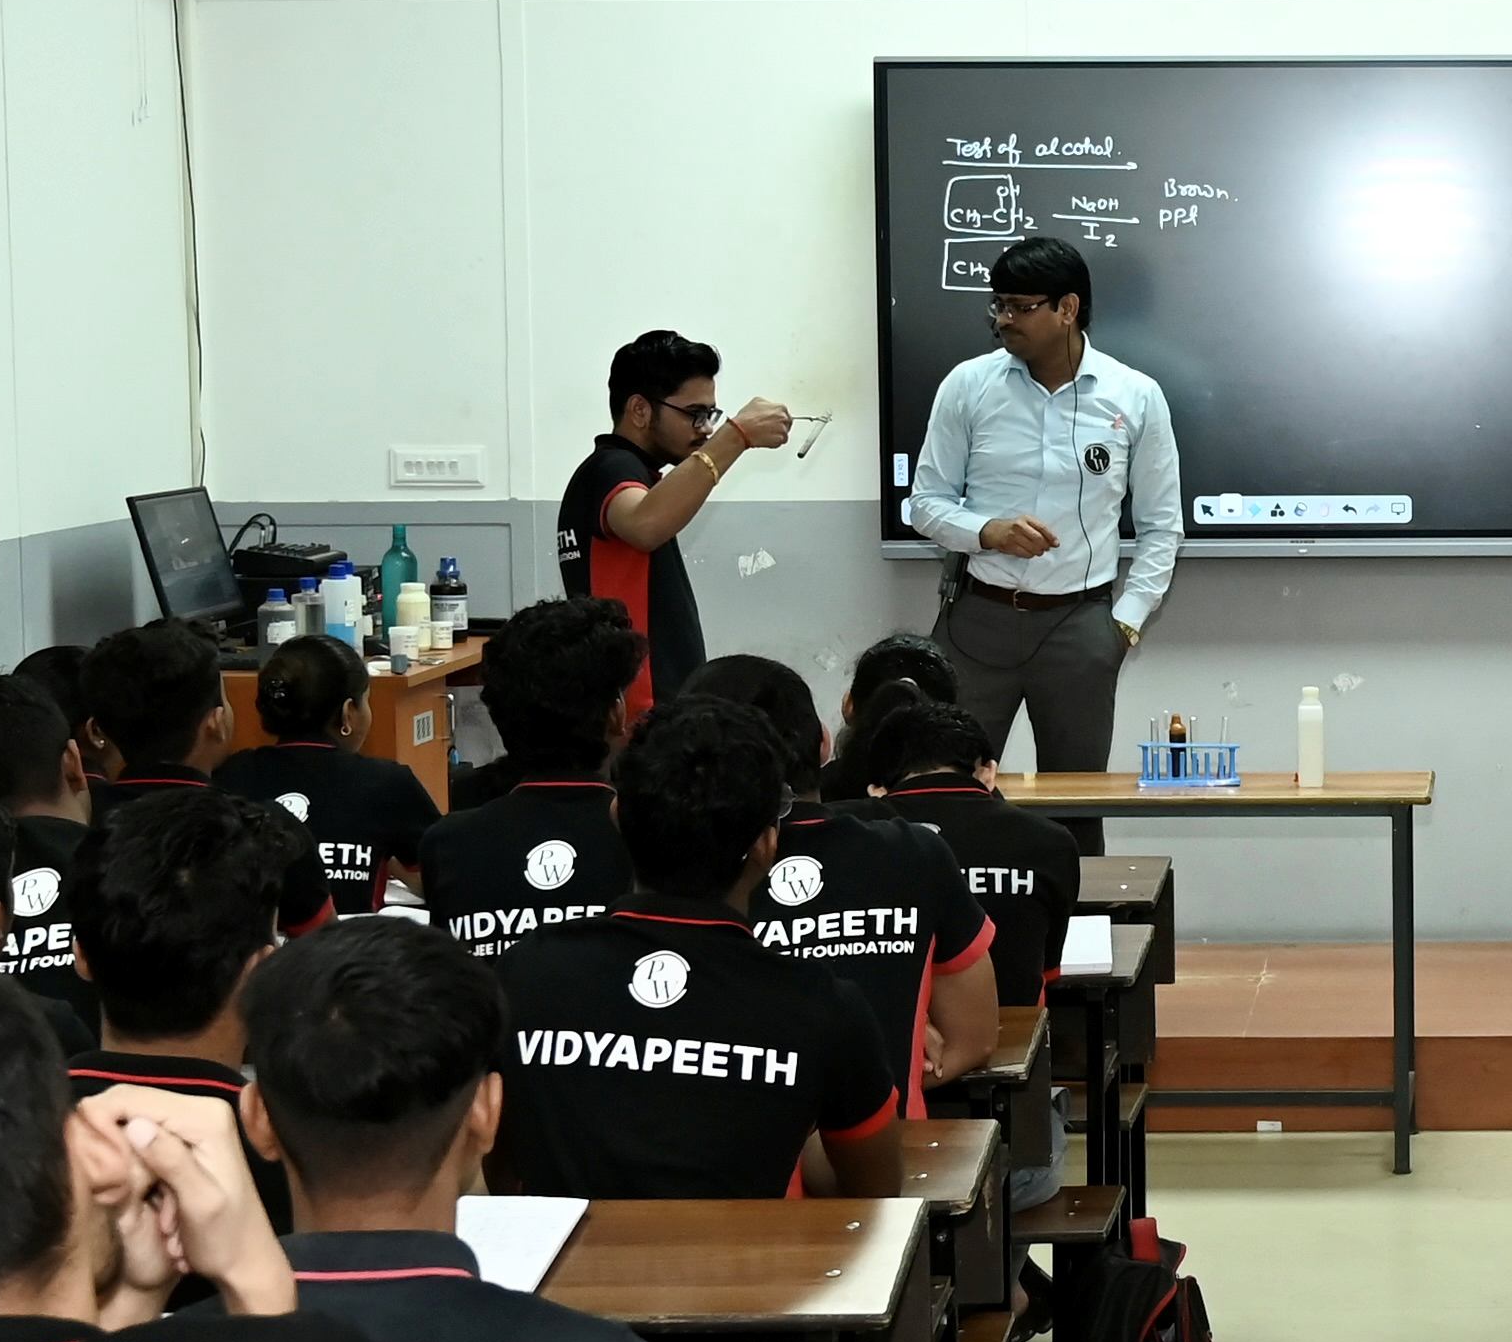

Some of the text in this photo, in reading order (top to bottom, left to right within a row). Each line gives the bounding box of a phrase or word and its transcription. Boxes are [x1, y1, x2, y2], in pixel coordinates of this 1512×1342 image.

[318, 842, 372, 867] ETH
[803, 941, 914, 959] FOUNDATION
[517, 1030, 798, 1086] VIDYAPEETH
